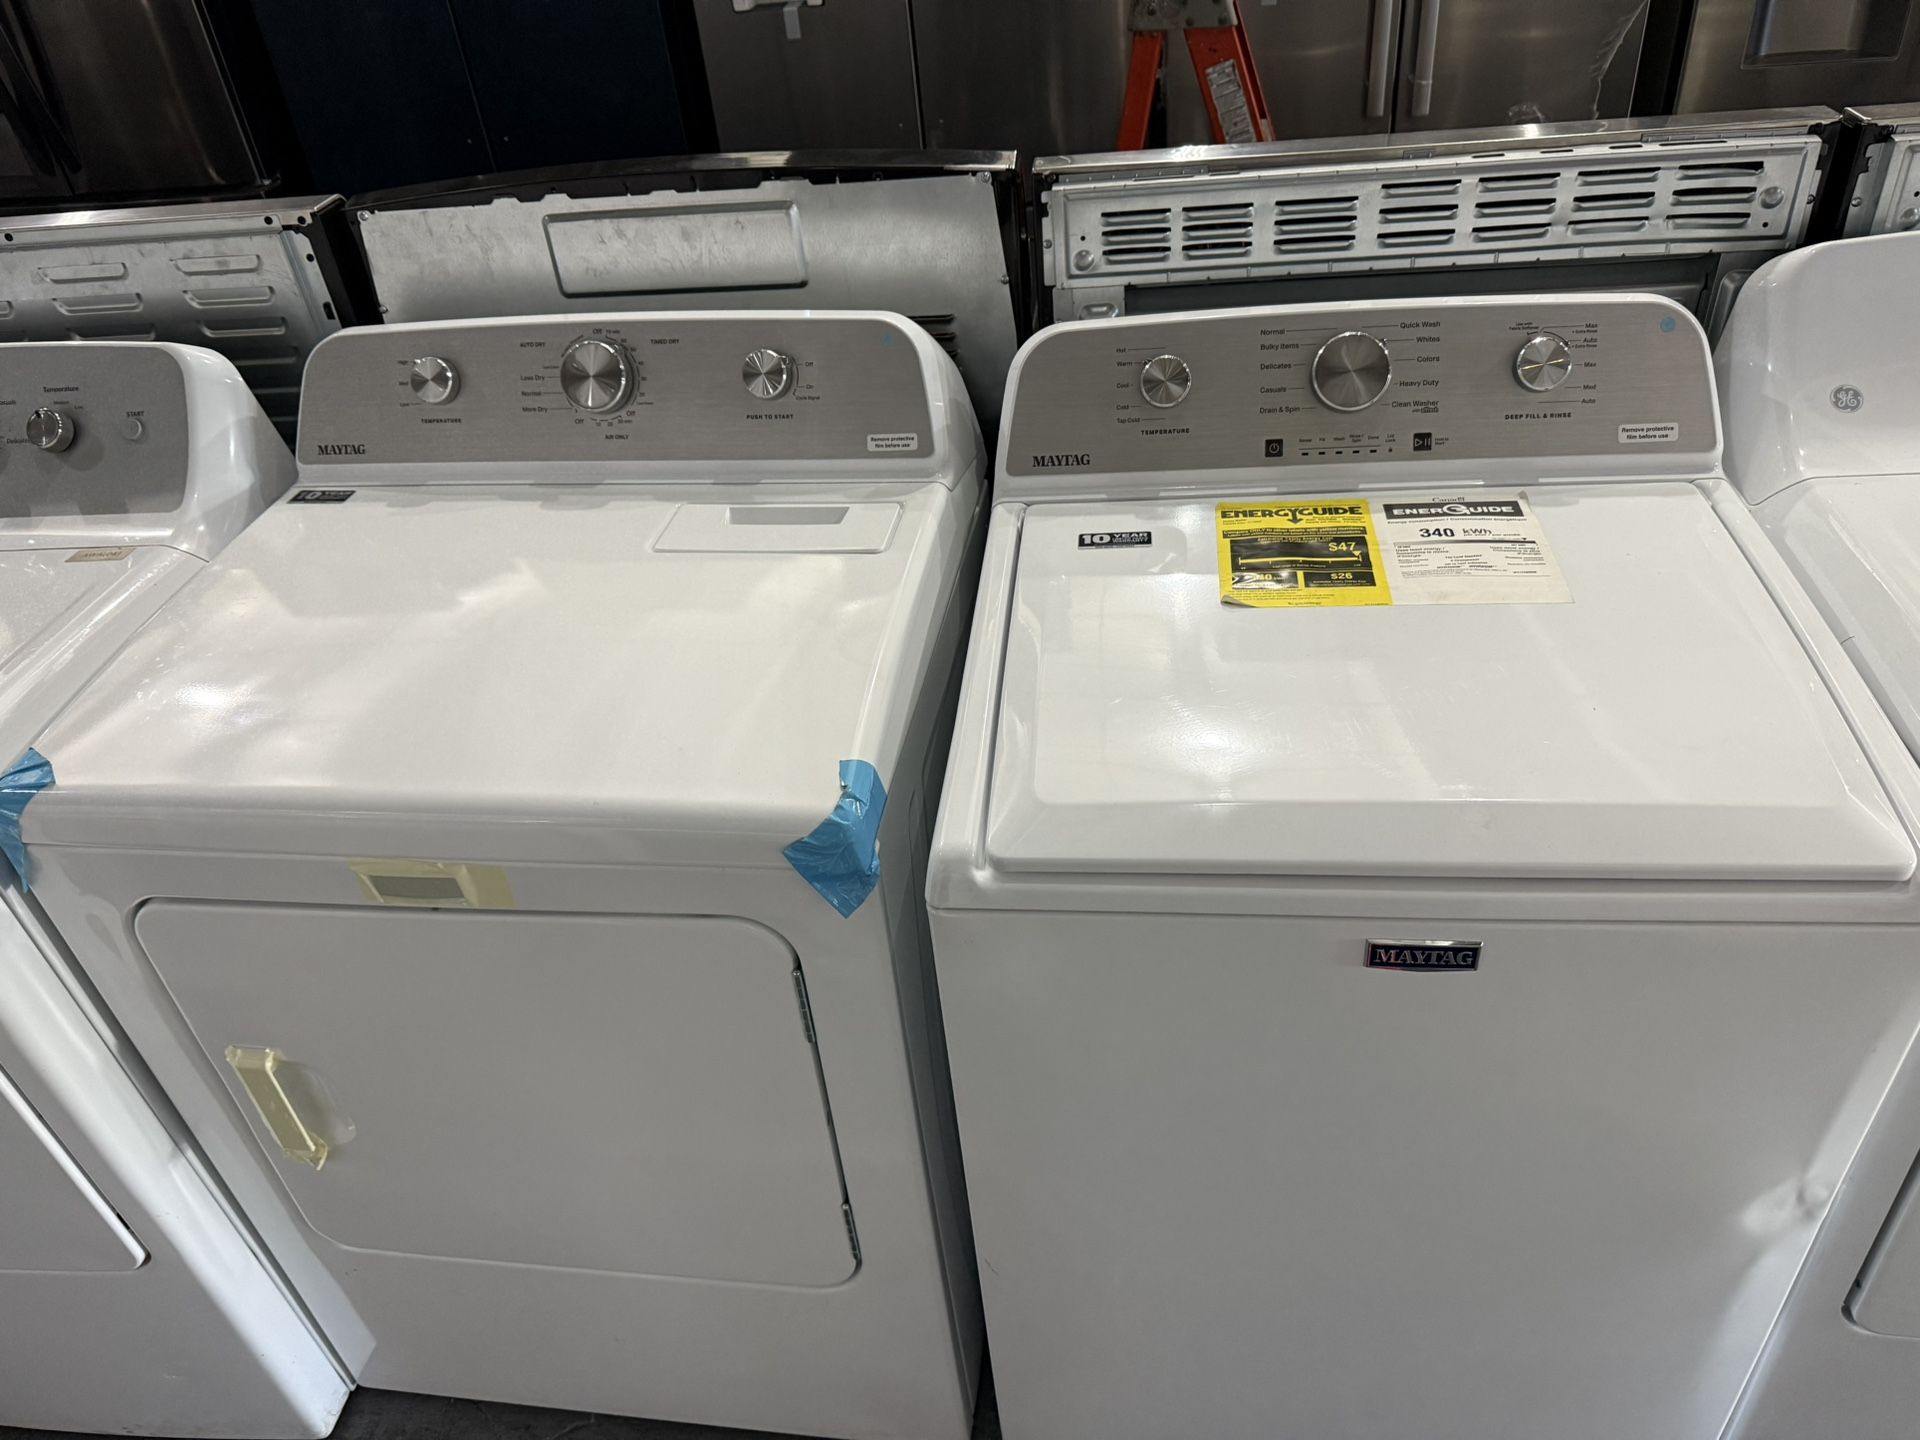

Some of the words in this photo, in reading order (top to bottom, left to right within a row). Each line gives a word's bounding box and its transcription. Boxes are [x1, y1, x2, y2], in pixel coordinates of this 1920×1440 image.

[1260, 328, 1285, 336] Normal
[1261, 343, 1279, 351] Bulky
[1280, 342, 1300, 350] Items
[1417, 355, 1440, 363] Colors
[1260, 362, 1292, 370] Delicates
[1399, 380, 1422, 388] Heavy
[1423, 379, 1440, 388] Duty
[1260, 386, 1287, 394] Casuals
[1413, 399, 1440, 407] Washer
[538, 406, 548, 414] Dry
[1259, 406, 1278, 414] Drain
[1284, 406, 1300, 414] Spin
[1141, 428, 1190, 436] TEMPERATURE
[1645, 425, 1675, 433] protective
[317, 444, 366, 456] MAYTAG
[1032, 453, 1091, 468] MAYTAG
[1221, 506, 1363, 521] ENERGYGUIDE
[1419, 527, 1456, 538] 340
[1462, 527, 1492, 535] kWh
[1081, 534, 1111, 545] 10
[1328, 542, 1356, 552] $47
[1330, 572, 1353, 580] $26
[1373, 948, 1473, 965] MAYTAG
